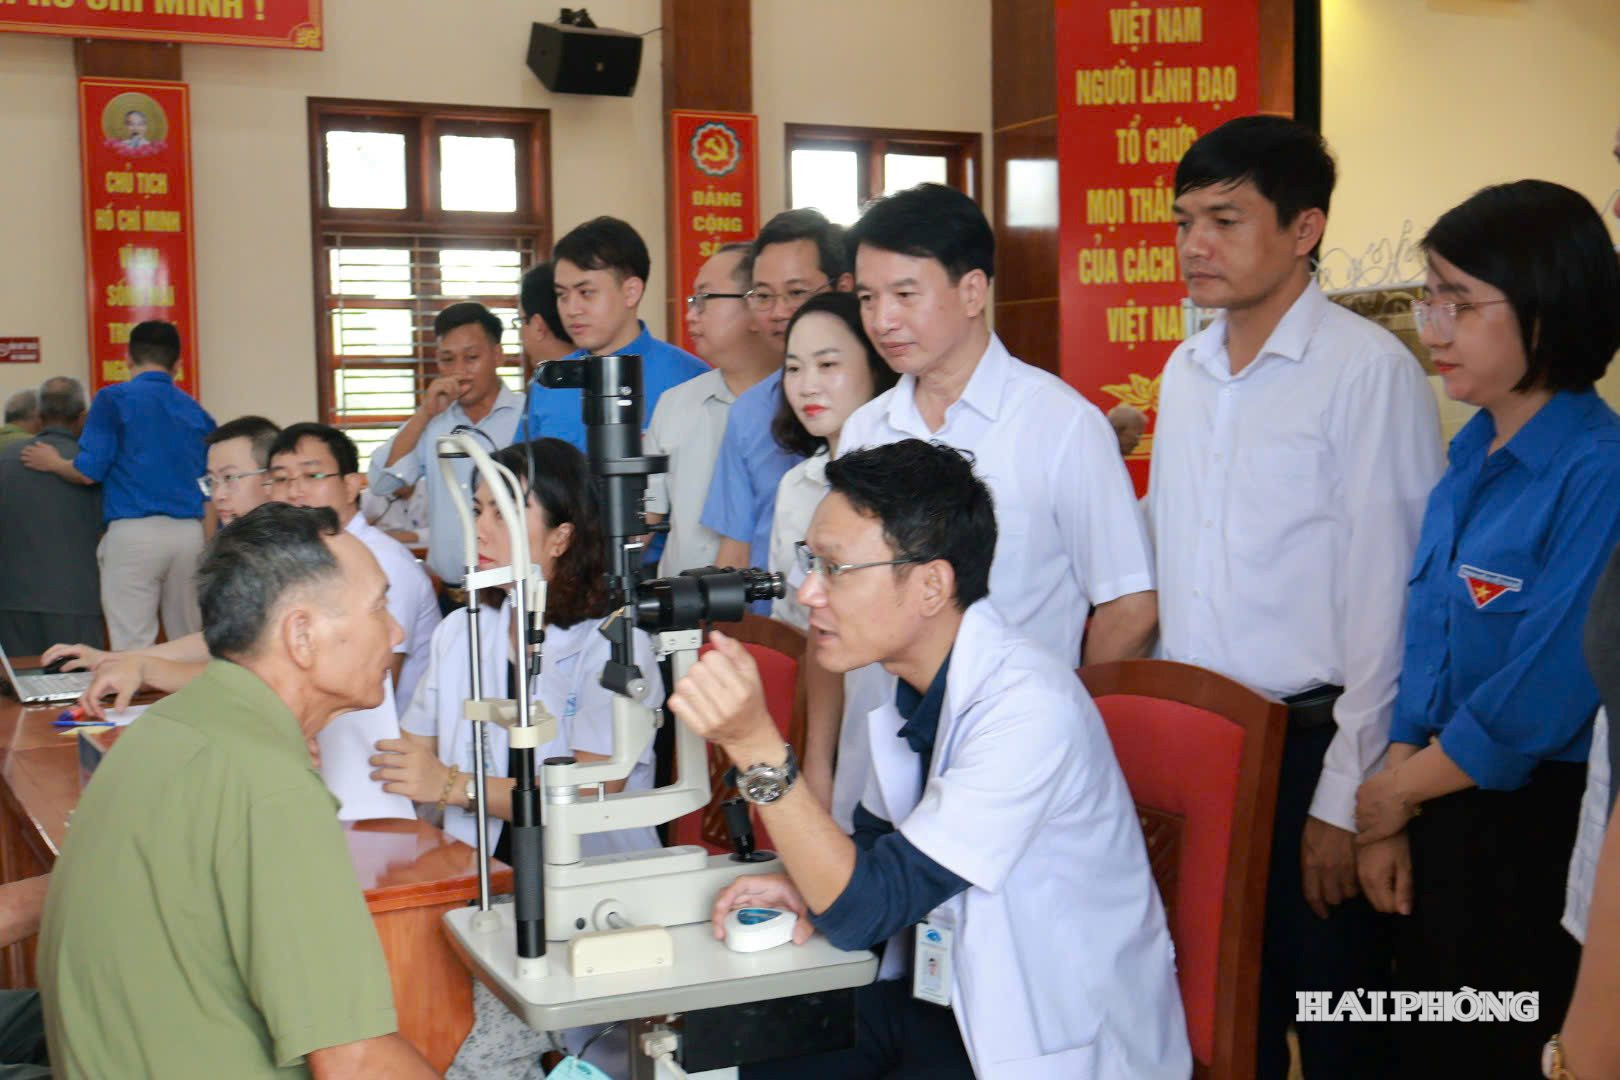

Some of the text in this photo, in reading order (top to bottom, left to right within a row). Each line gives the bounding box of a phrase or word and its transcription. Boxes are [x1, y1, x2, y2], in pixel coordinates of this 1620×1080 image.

[1110, 0, 1202, 52] VIỆT NAM
[1076, 59, 1237, 111] NGƯỜI LÃNH ĐẠO
[1115, 113, 1141, 165] TỔ
[691, 185, 743, 208] ĐẢNG
[1086, 188, 1126, 232] MỌI
[692, 213, 743, 234] CỘNG
[1078, 232, 1176, 285] CỦA CÁCH
[1106, 298, 1185, 350] VIỆT NA
